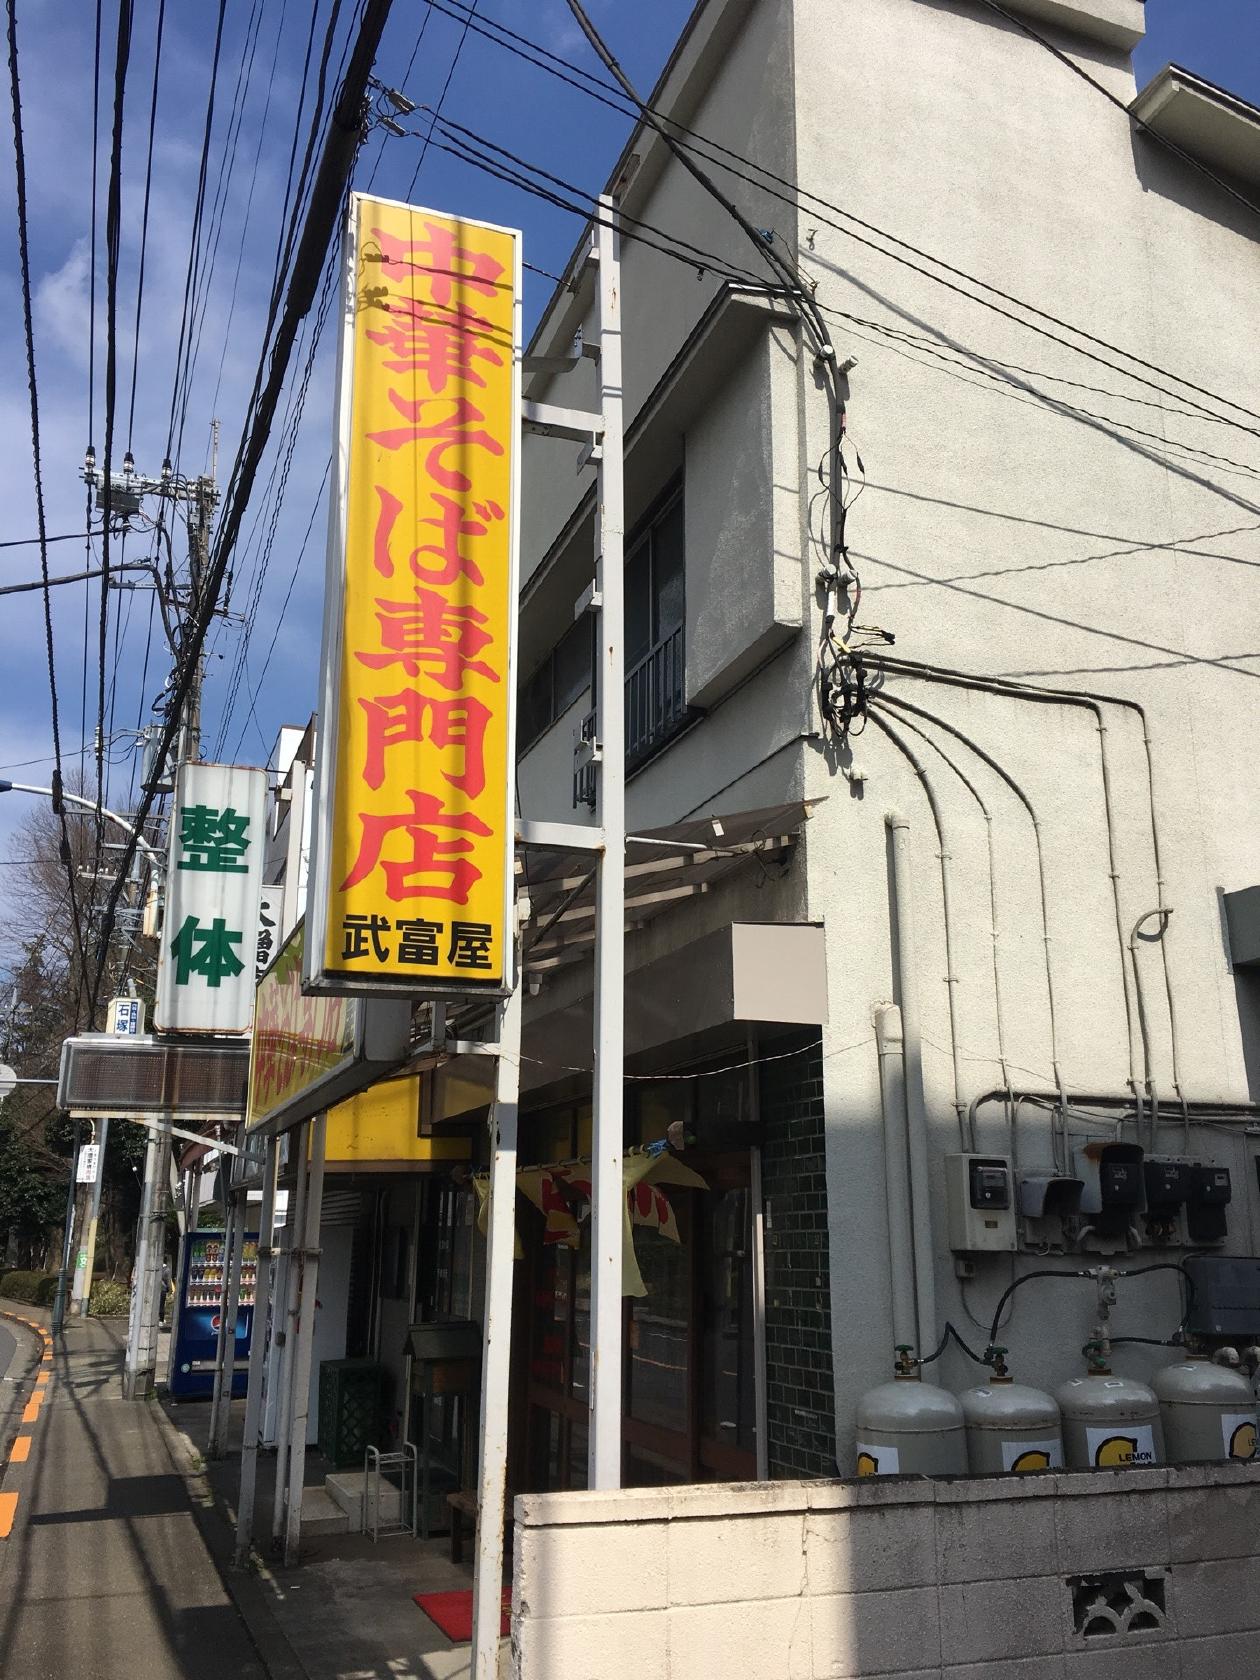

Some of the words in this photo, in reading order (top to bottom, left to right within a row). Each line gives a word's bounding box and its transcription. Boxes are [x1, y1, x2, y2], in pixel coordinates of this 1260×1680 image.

[338, 221, 506, 906] 中華そば専門店
[170, 805, 252, 987] 整体
[341, 914, 493, 969] 武富屋
[1118, 1451, 1153, 1462] LEMON
